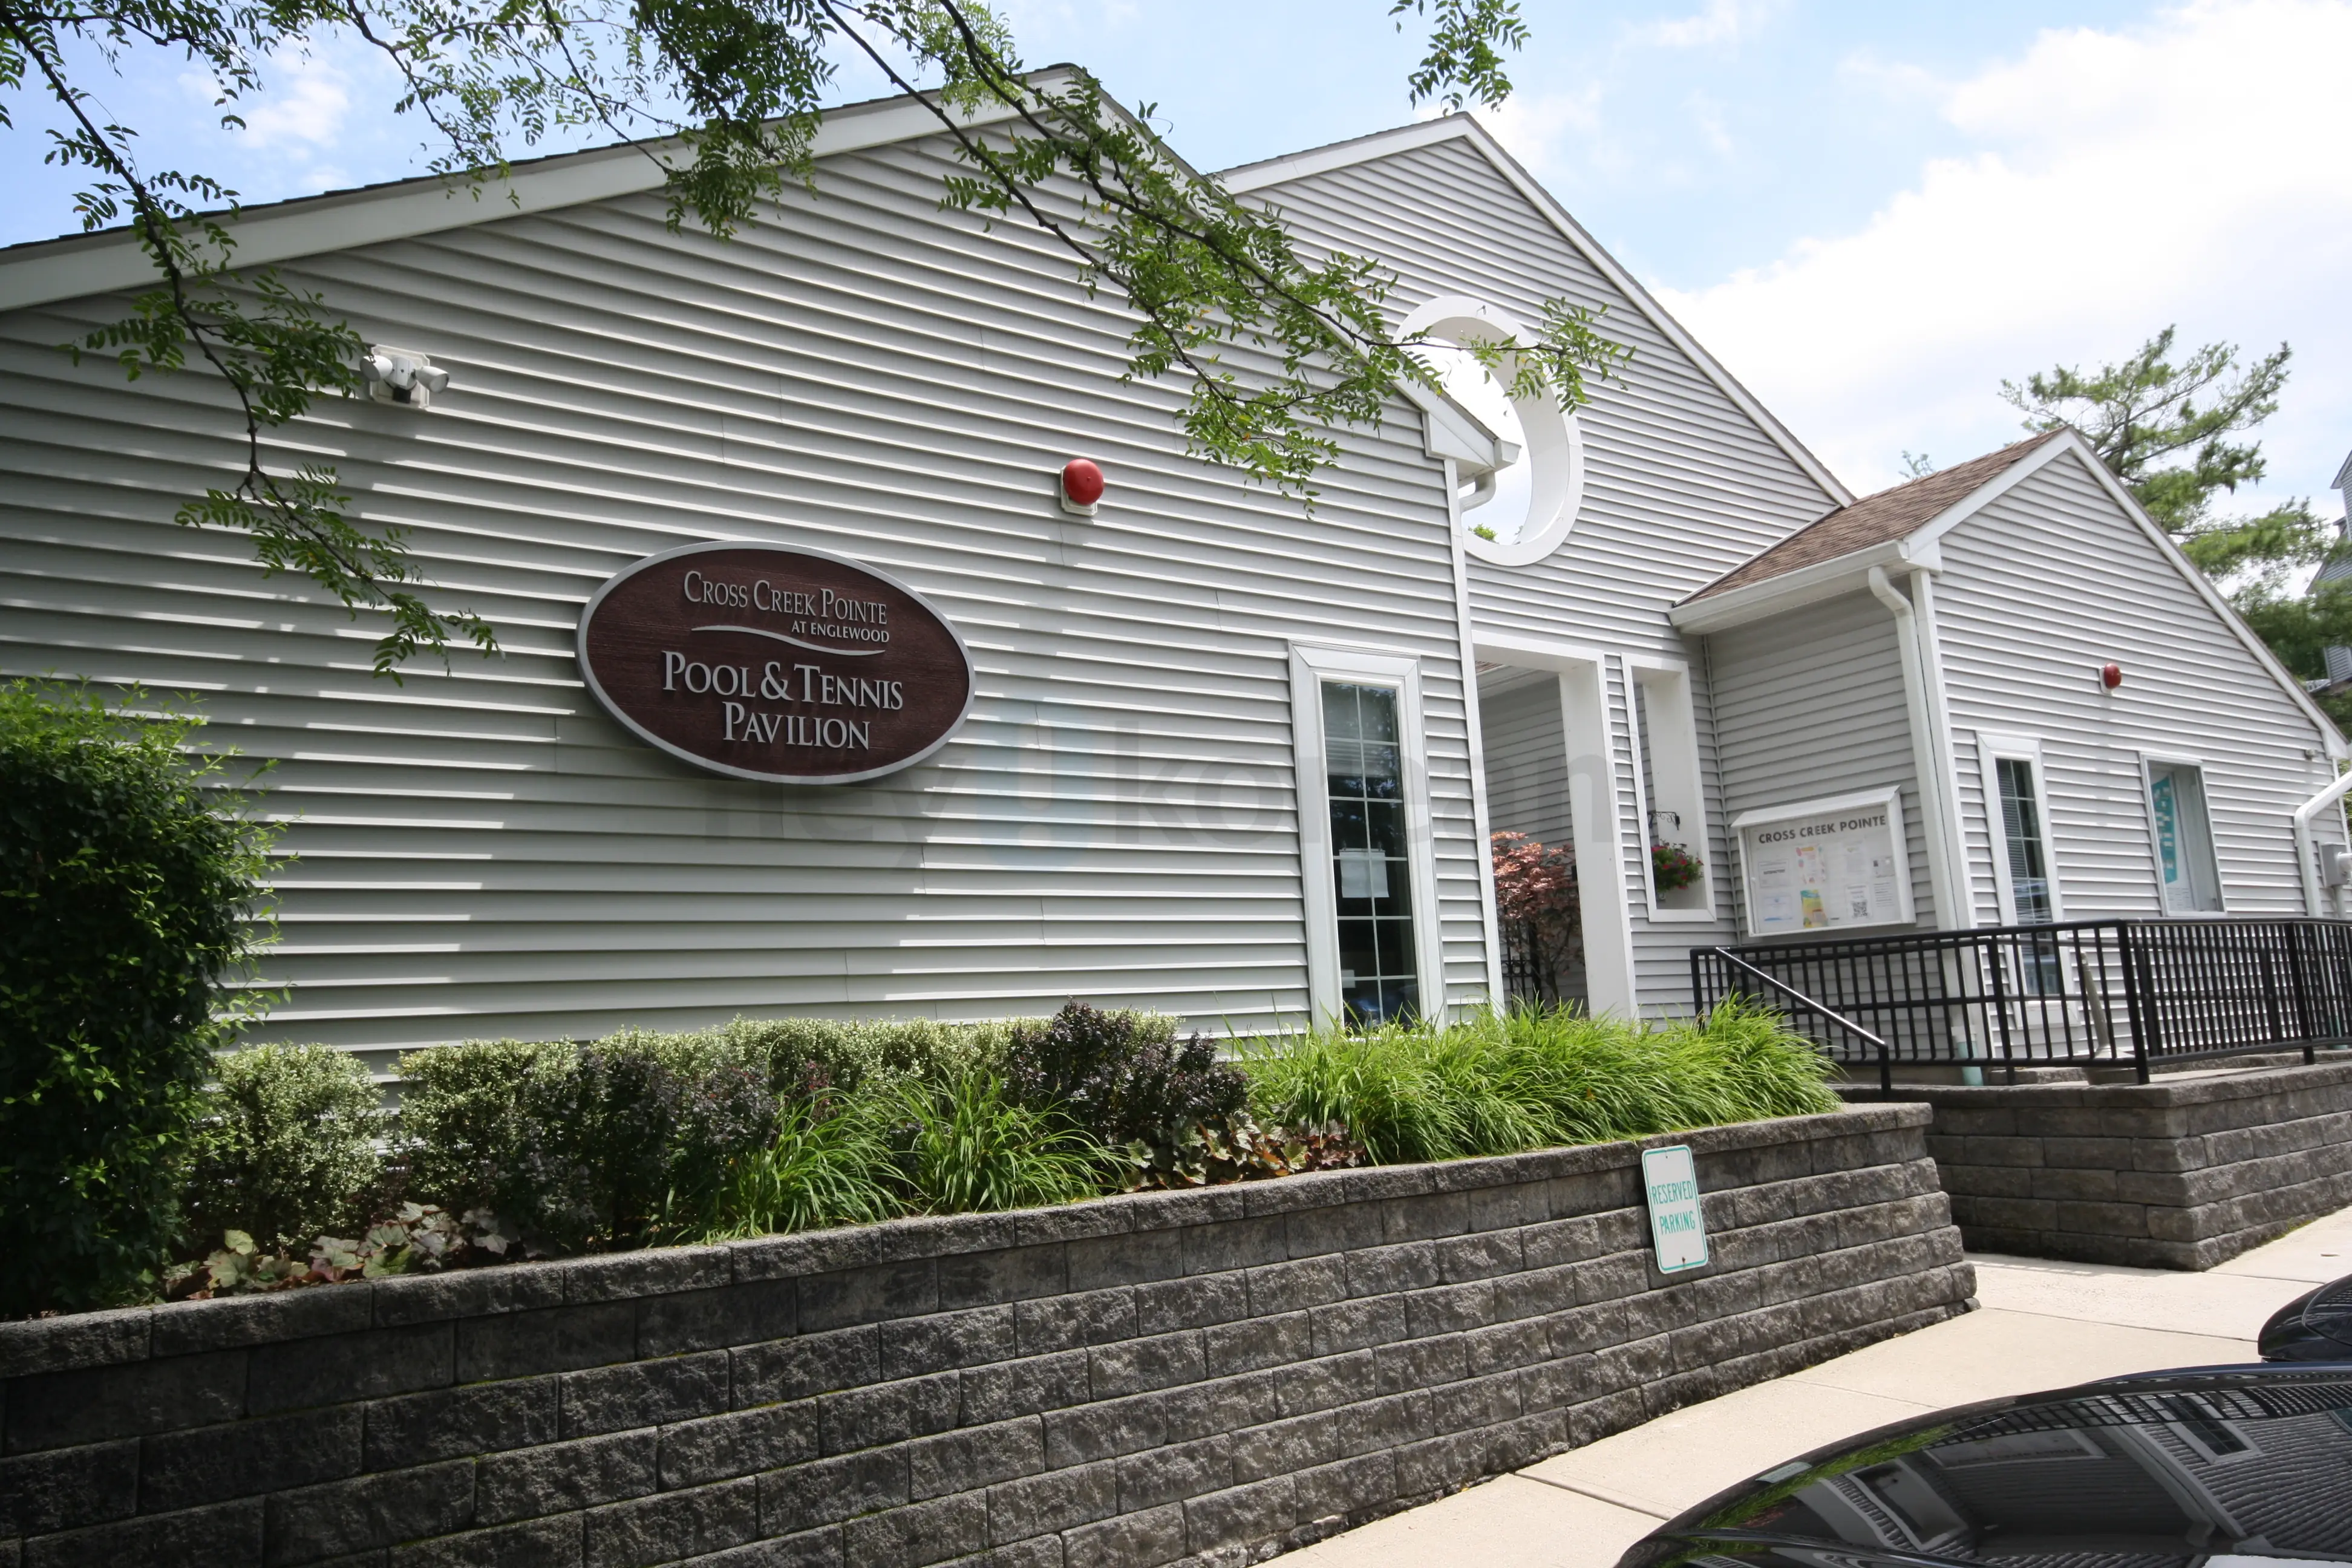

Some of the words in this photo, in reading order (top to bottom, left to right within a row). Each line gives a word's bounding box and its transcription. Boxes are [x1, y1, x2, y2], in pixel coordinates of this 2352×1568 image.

[684, 570, 748, 607] CROSS
[754, 580, 816, 616] CREEK
[821, 589, 887, 624] POINTE
[791, 621, 807, 633] AT
[811, 623, 889, 642] ENGLEWOOD
[662, 651, 755, 697] POOL
[761, 661, 793, 701] &
[795, 664, 903, 710] TENNIS
[723, 702, 870, 750] PAVILION
[1759, 829, 1795, 844] CROSS
[1800, 823, 1836, 837] CREEK
[1840, 815, 1886, 831] POINTE
[1651, 1181, 1693, 1204] RESERVED
[1659, 1210, 1696, 1235] PARKING
